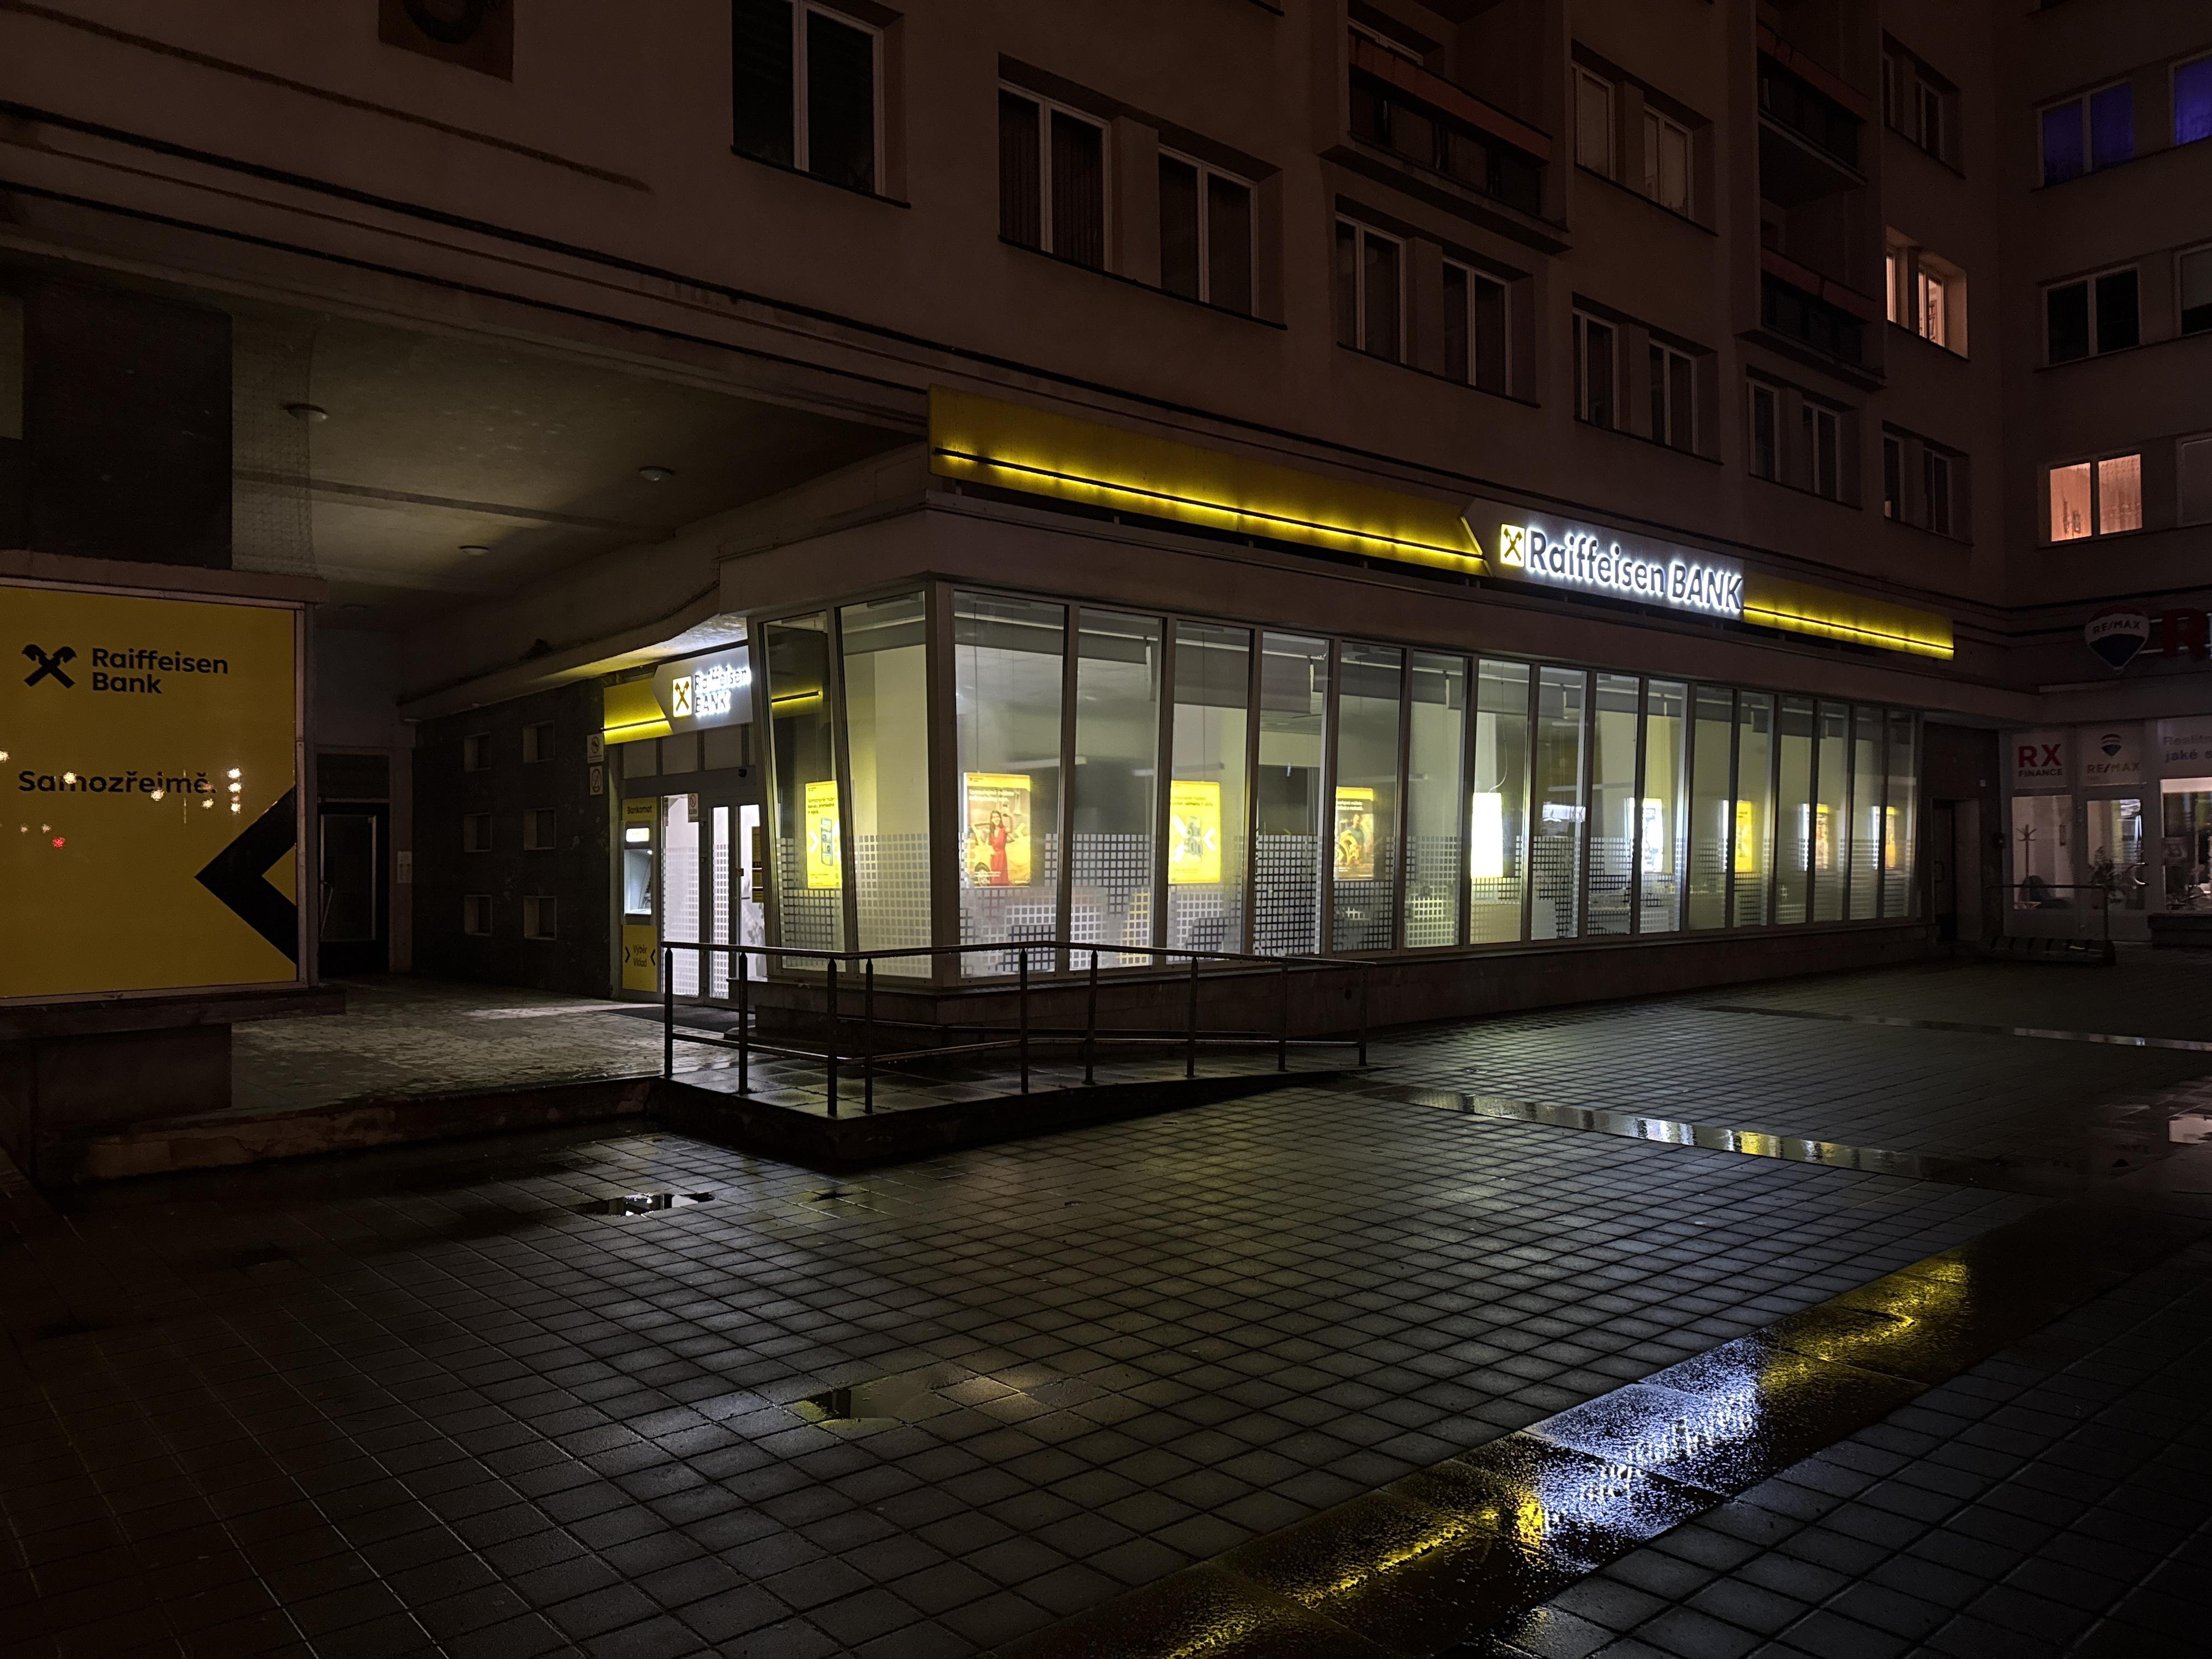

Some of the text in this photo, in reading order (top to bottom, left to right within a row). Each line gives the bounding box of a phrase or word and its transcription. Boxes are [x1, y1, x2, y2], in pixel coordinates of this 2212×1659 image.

[1528, 528, 1742, 611] Raiffeisen BANK
[2093, 620, 2141, 634] RE/MAX
[92, 648, 228, 674] Raiffeisen
[92, 671, 163, 694] Bank
[695, 690, 727, 713] BANK
[2018, 743, 2062, 768] RX
[2018, 768, 2063, 778] FINANCE
[2086, 761, 2140, 774] RE/MAX
[627, 805, 653, 815] Bankomat
